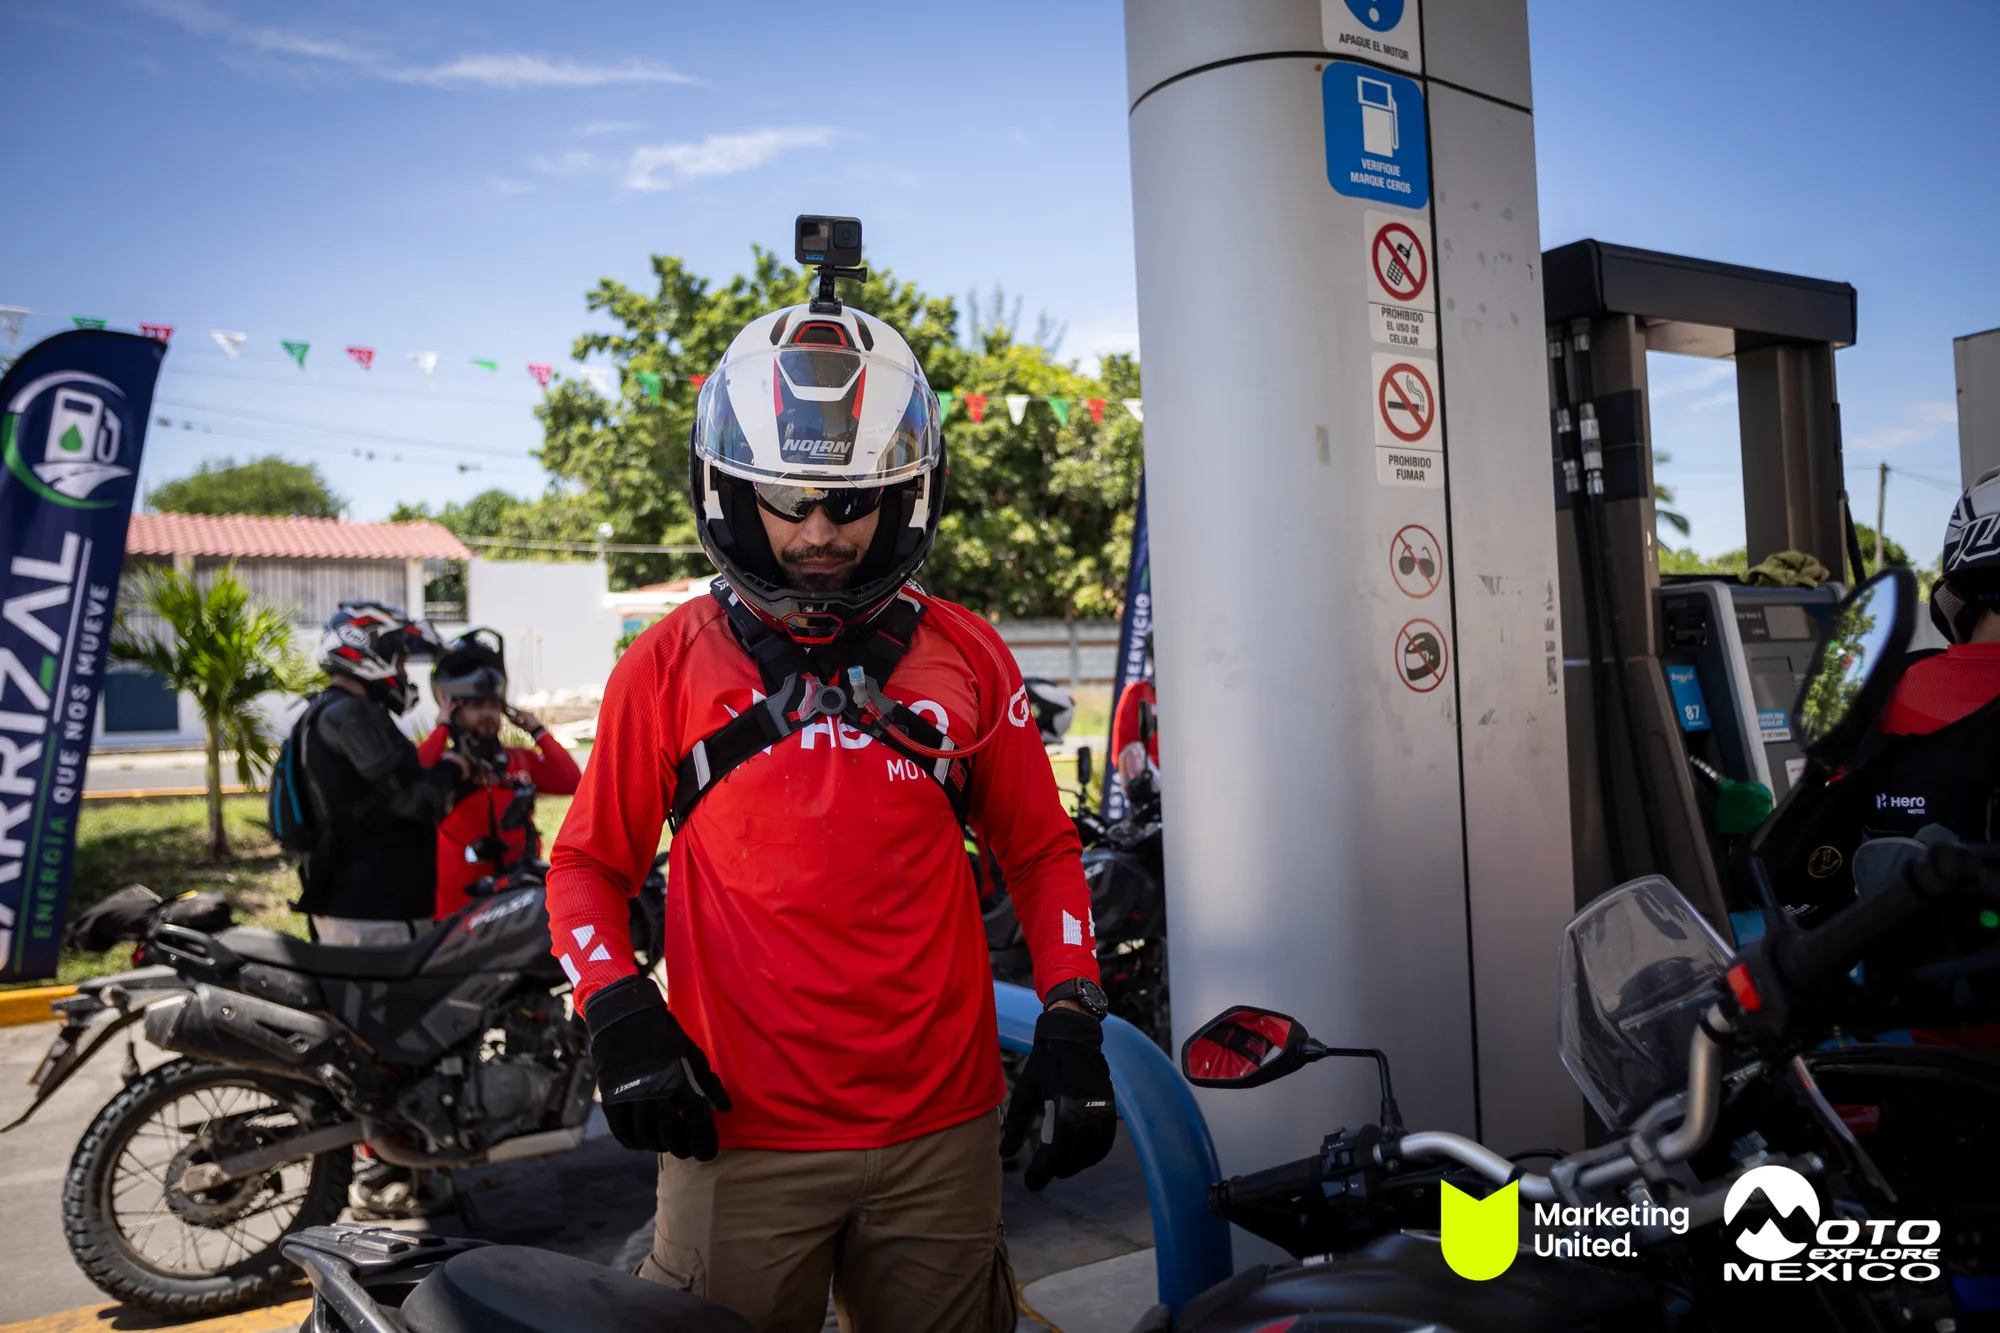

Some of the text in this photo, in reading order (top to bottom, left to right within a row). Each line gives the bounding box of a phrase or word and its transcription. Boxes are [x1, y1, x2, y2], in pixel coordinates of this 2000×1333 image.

[1339, 33, 1409, 61] APAGUE EL MOTOR
[1361, 158, 1401, 176] VERIFIQUE
[1350, 172, 1411, 194] MARQUE CEROS
[1381, 307, 1424, 323] PROHIBIDO
[1386, 321, 1420, 335] EL USO DE
[1389, 333, 1418, 346] CELULAR
[782, 438, 851, 455] NOLAN
[1388, 454, 1432, 469] PROHIBIDO
[1396, 468, 1425, 481] FUMAR
[75, 583, 110, 676] MUEVE
[64, 684, 91, 741] NOS
[1685, 704, 1700, 721] 87
[52, 748, 80, 804] QUE
[1890, 796, 1926, 808] Hero
